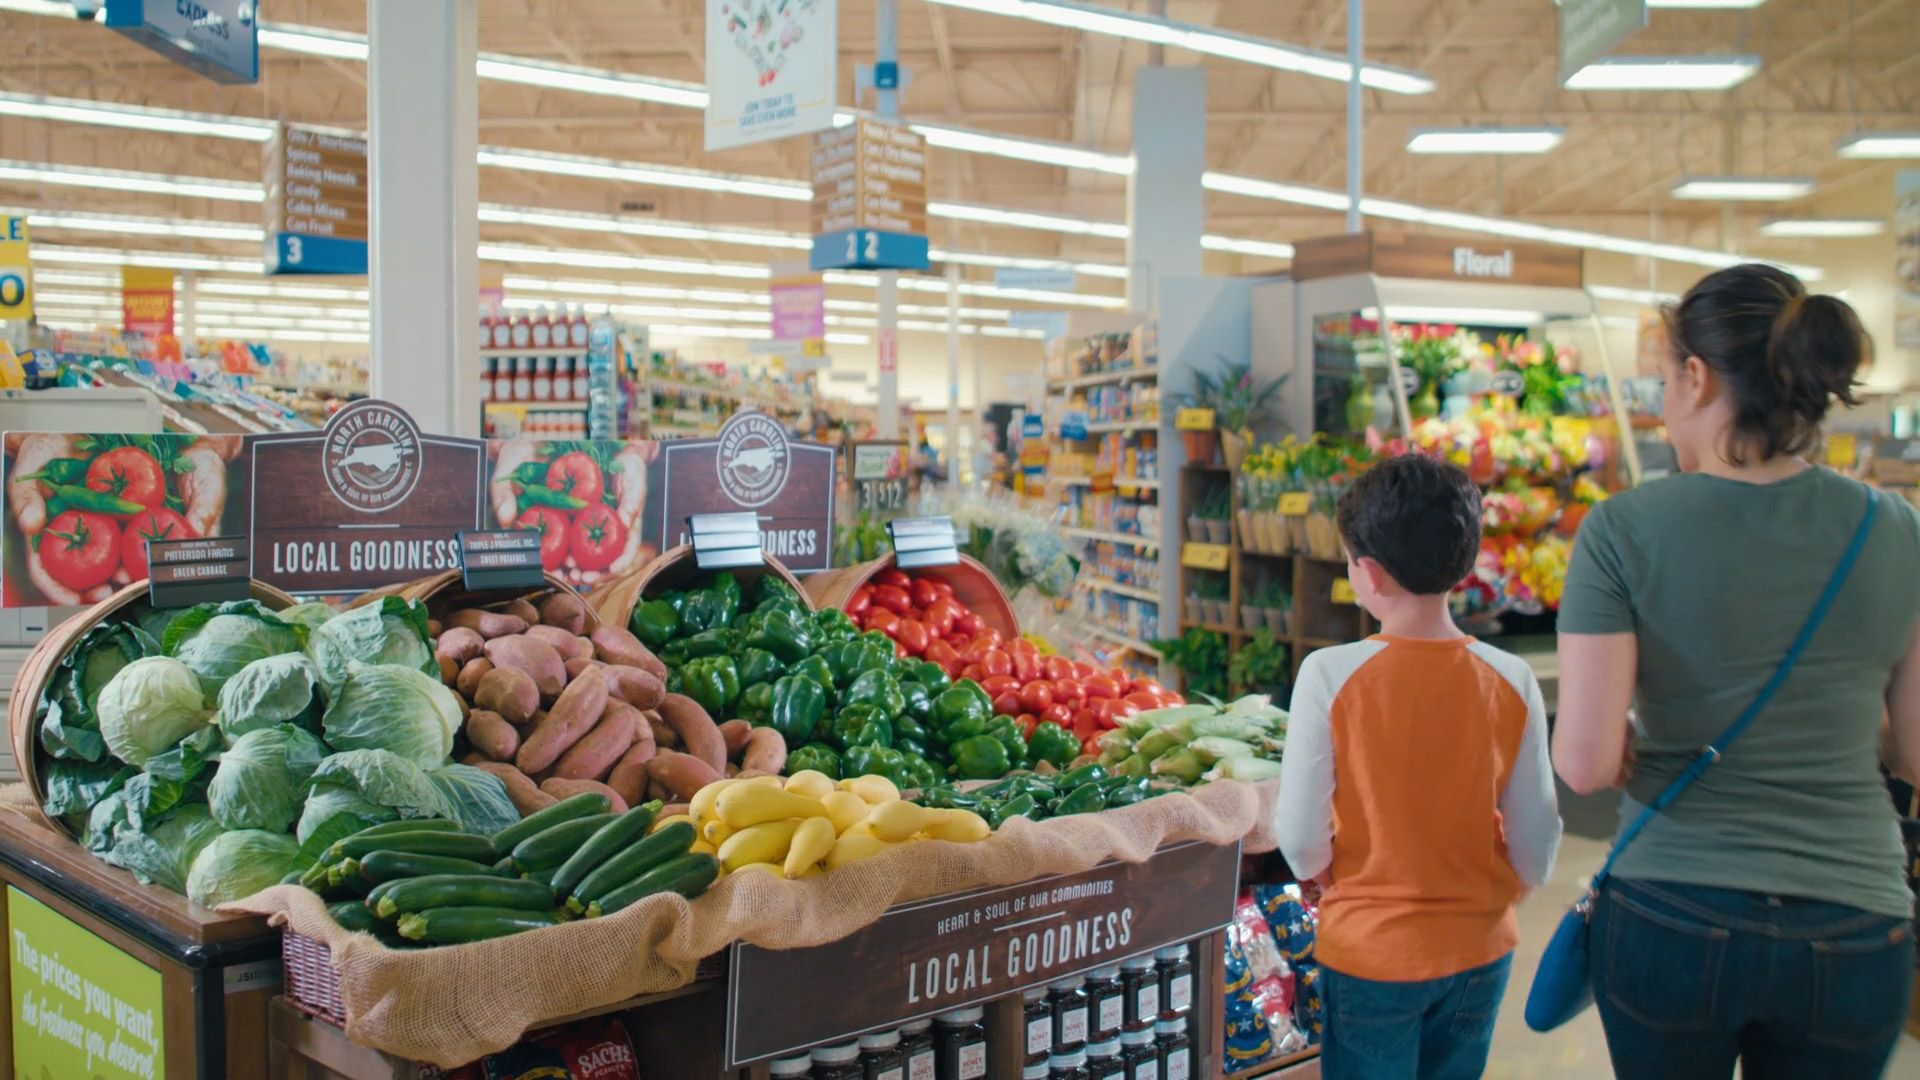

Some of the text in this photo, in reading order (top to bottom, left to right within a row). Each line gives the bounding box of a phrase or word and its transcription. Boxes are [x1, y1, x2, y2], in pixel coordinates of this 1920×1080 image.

[286, 146, 321, 163] Spices
[286, 163, 322, 182] Baking
[286, 181, 321, 199] Candy
[286, 198, 313, 216] Cake
[286, 216, 335, 235] Can Fruit
[286, 236, 303, 264] 3
[865, 231, 879, 260] 2
[1452, 246, 1514, 278] Floral
[331, 411, 414, 456] NORTH CAROLINA
[723, 420, 785, 458] NORTH CAROLINA
[164, 547, 235, 561] PATTERSON FARMS
[273, 539, 459, 573] LOCAL GOODNESS
[758, 529, 817, 556] ODNESS
[173, 565, 228, 578] GREEN CABBAGE
[937, 879, 1114, 936] HEART & SOUL OF OUR COMMUNITIES
[908, 907, 1133, 1004] LOCAL GOODNESS
[14, 928, 159, 1055] The prices you want,
[22, 989, 38, 1027] the
[38, 997, 84, 1049] freshness
[85, 1028, 106, 1072] you
[912, 1065, 932, 1076] HONEY
[962, 1057, 983, 1068] HONEY
